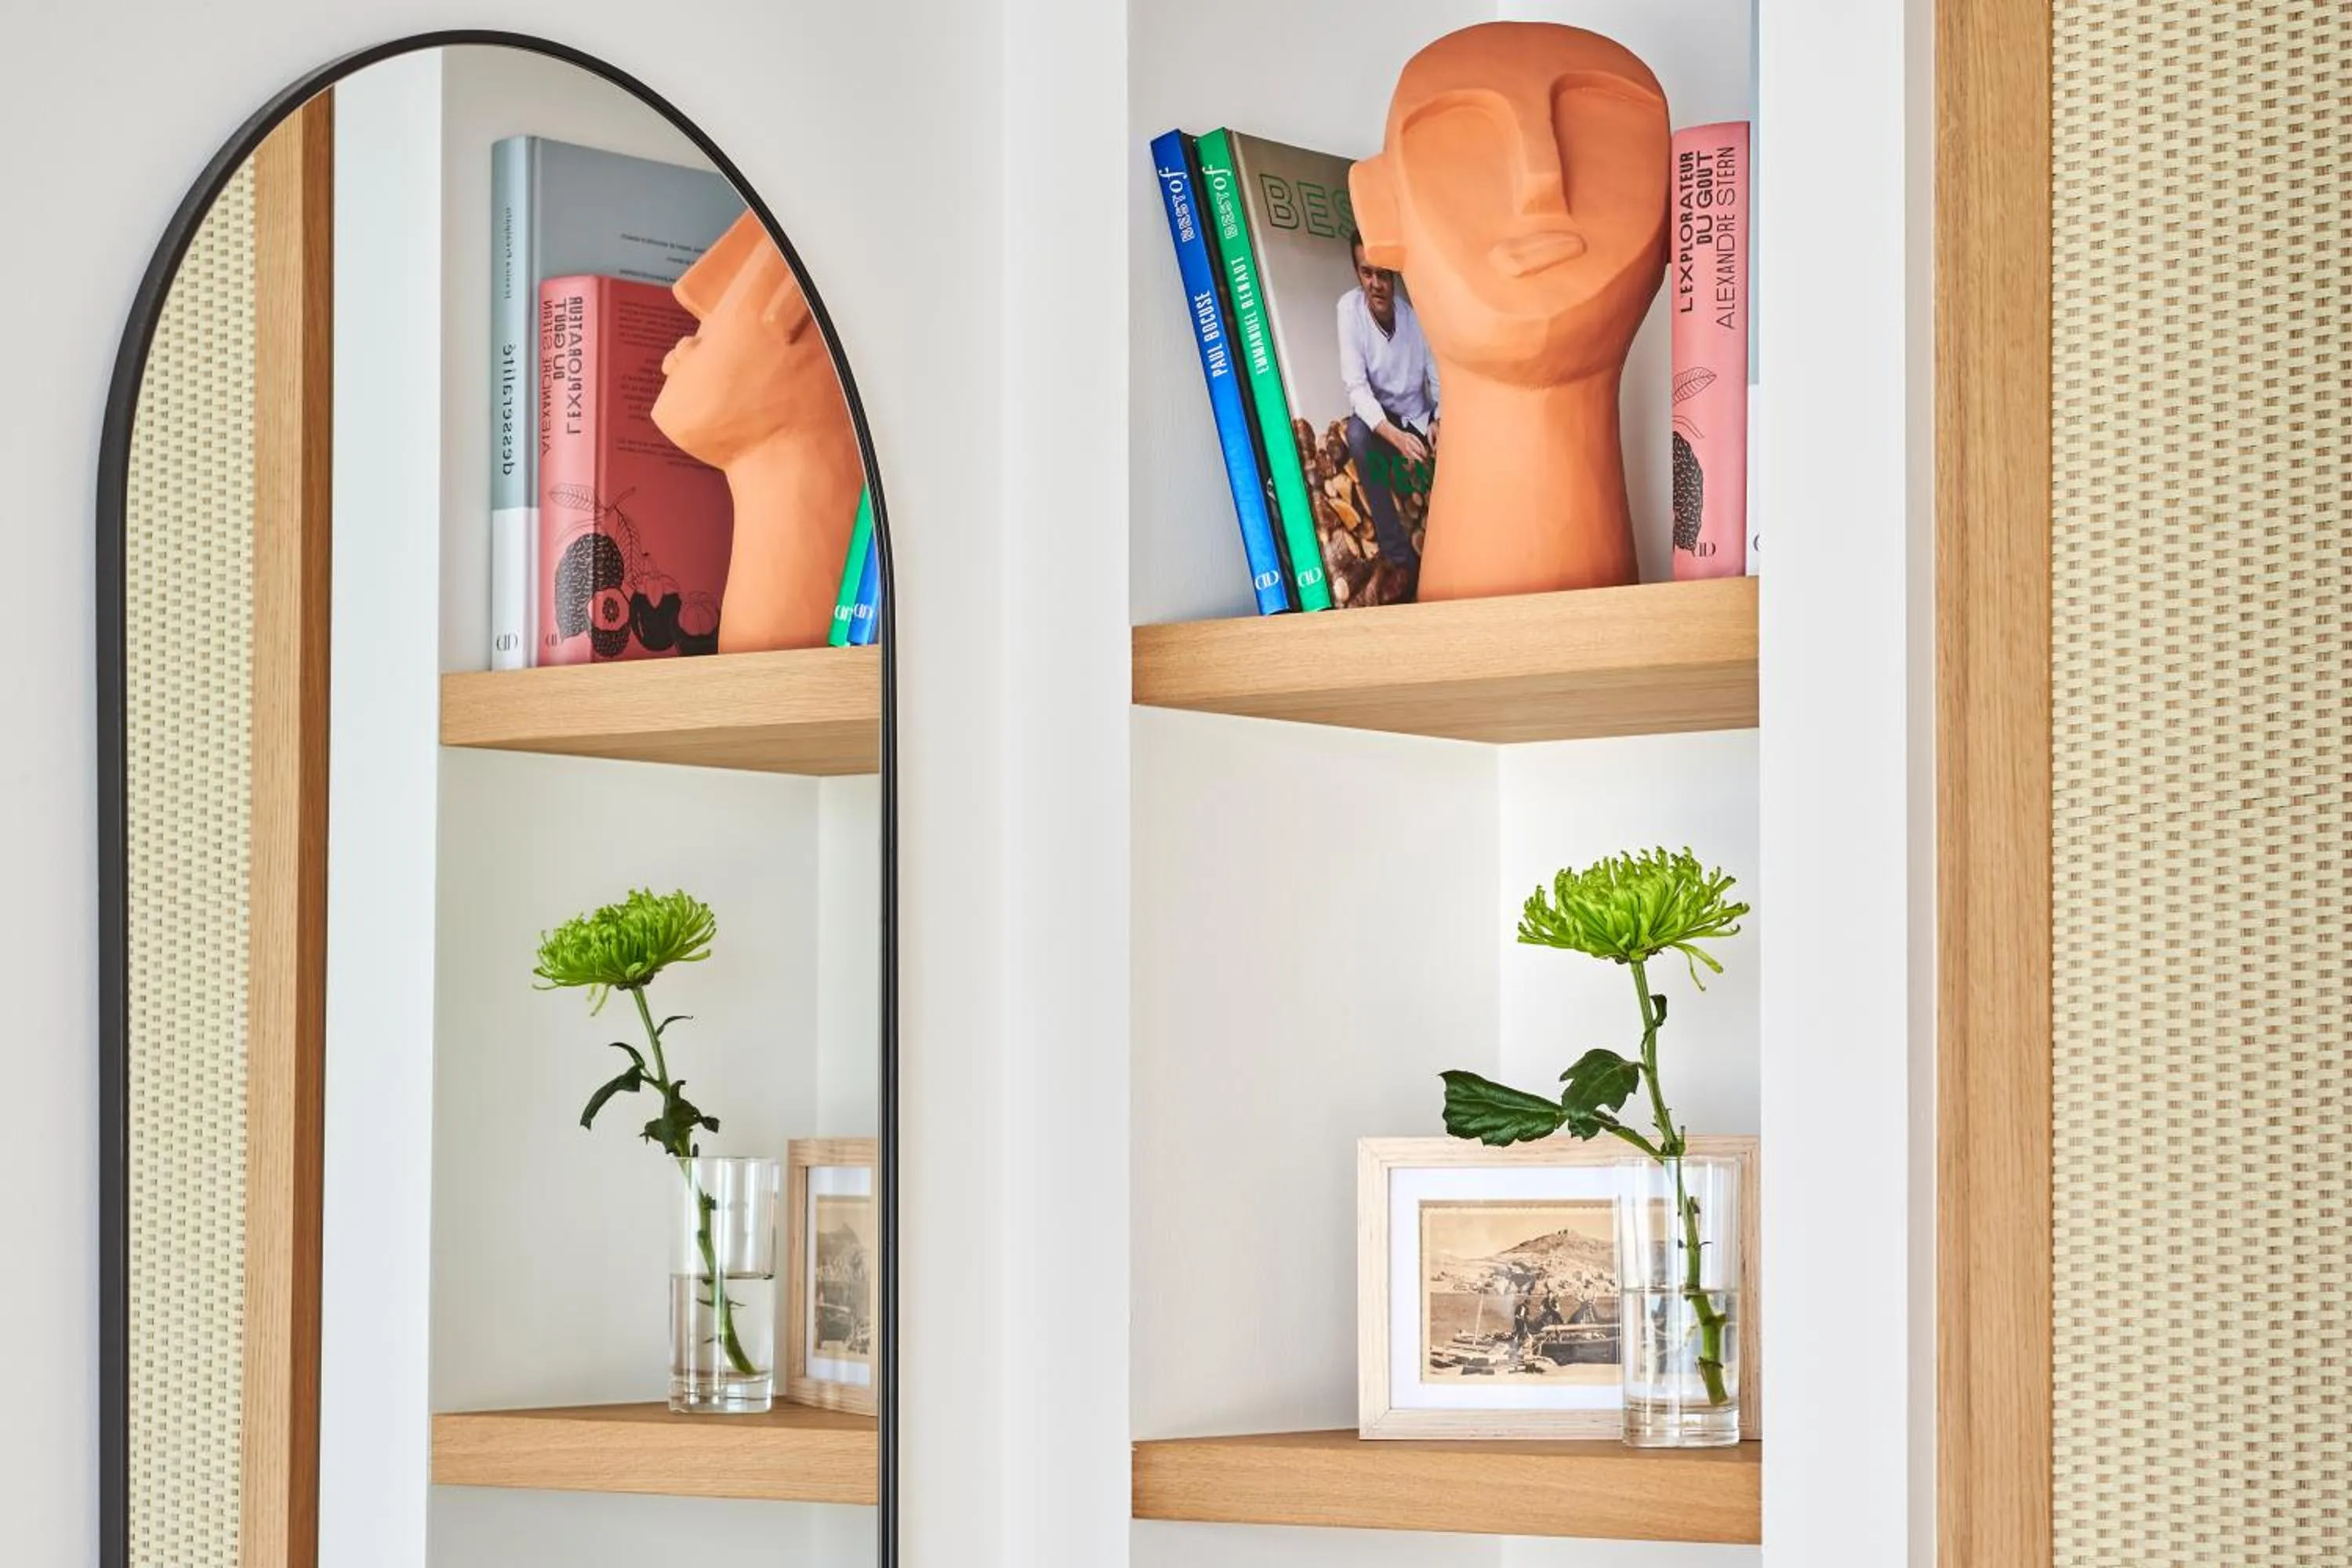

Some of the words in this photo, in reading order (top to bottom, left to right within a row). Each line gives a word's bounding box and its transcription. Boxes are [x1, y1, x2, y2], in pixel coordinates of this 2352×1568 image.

[1716, 146, 1736, 206] STERN
[1679, 151, 1695, 314] L'EXPLORATEUR
[1697, 216, 1713, 245] DU
[1230, 256, 1255, 310] RENAUT
[1716, 214, 1736, 329] ALEXANDRE
[1194, 289, 1220, 343] BOCUSE
[1244, 310, 1269, 376] EMMANUEL
[1207, 343, 1229, 379] PAUL
